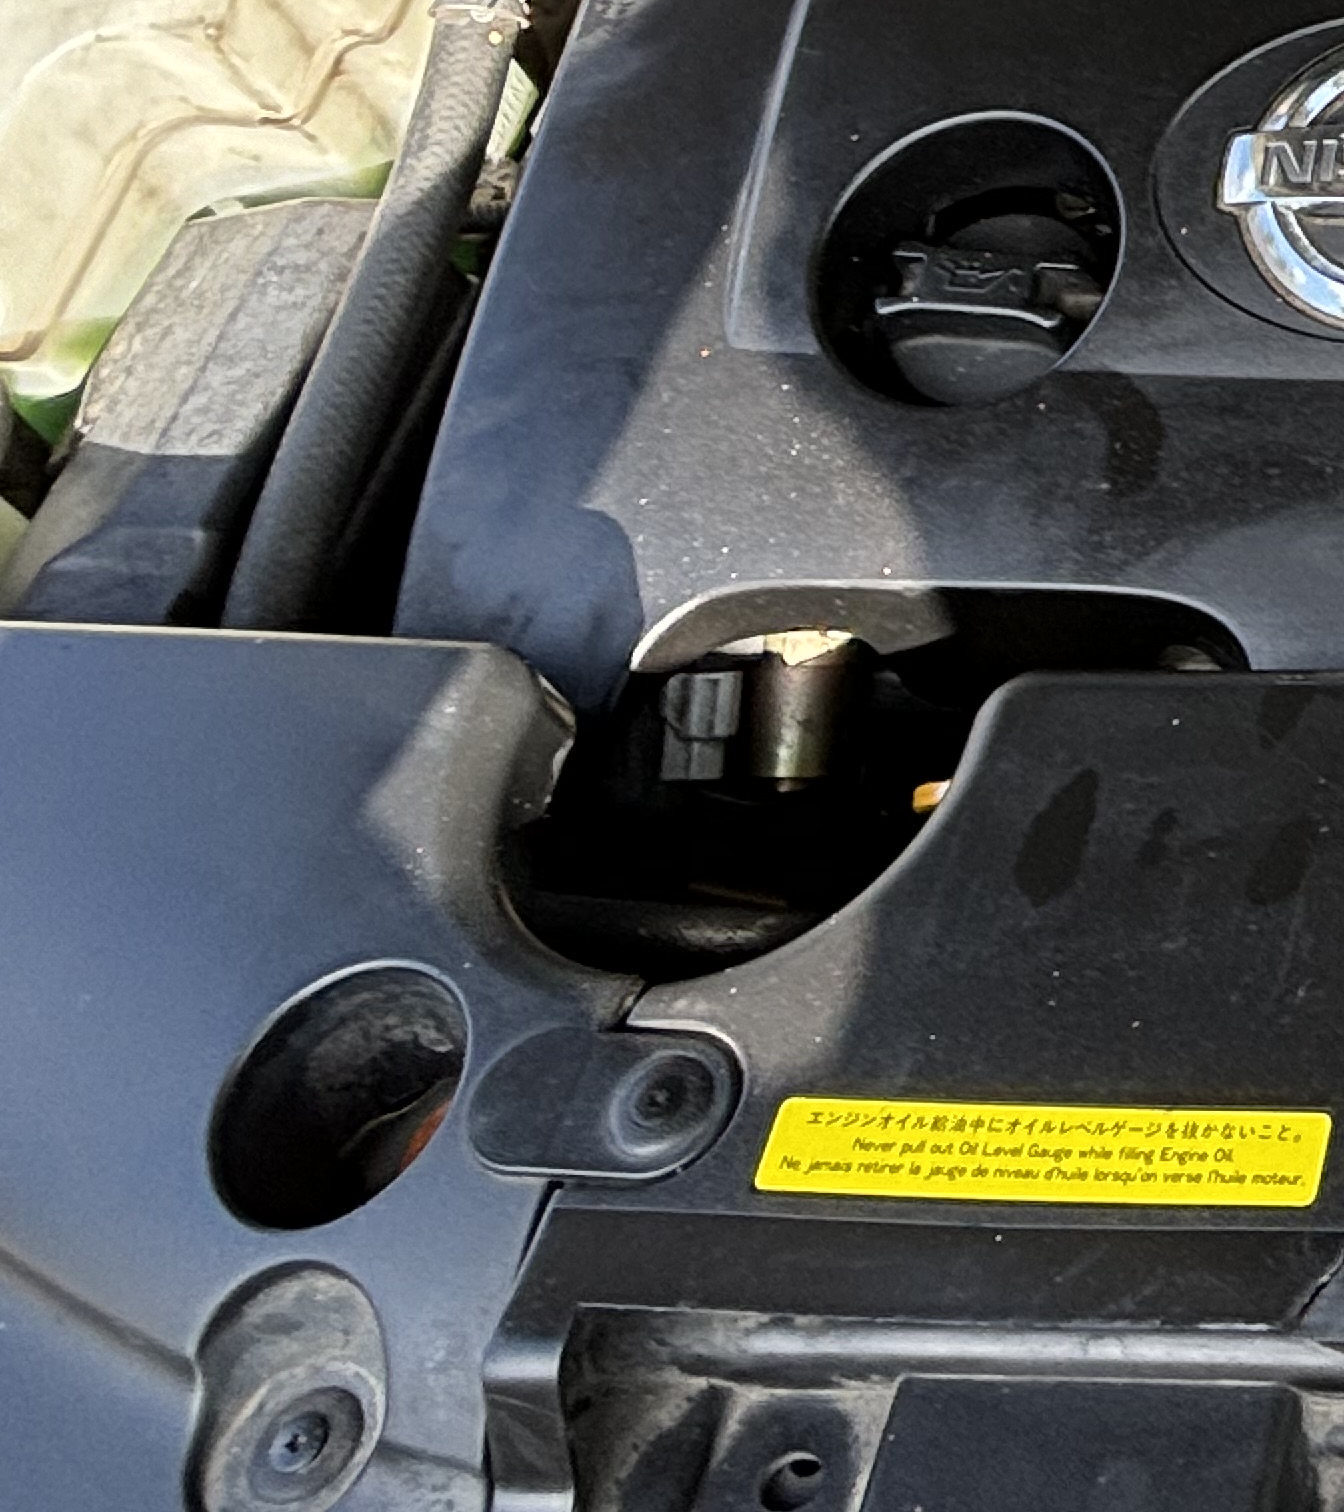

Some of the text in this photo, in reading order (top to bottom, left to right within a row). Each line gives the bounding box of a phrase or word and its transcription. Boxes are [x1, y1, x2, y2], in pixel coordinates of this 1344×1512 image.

[852, 1136, 897, 1153] Never
[899, 1139, 926, 1157] pull
[930, 1142, 954, 1155] out
[959, 1140, 979, 1156] Oil
[981, 1142, 1024, 1158] Level
[1027, 1143, 1073, 1163] Gauge
[1079, 1145, 1113, 1160] while
[1118, 1146, 1155, 1165] filling
[1159, 1146, 1209, 1166] Engine
[780, 1155, 801, 1170] Ne
[803, 1159, 852, 1175] jamais
[856, 1160, 905, 1174] retirer
[923, 1163, 967, 1181] jauge
[970, 1163, 989, 1178] de
[993, 1166, 1041, 1180] niveau
[1163, 1171, 1203, 1184] verse
